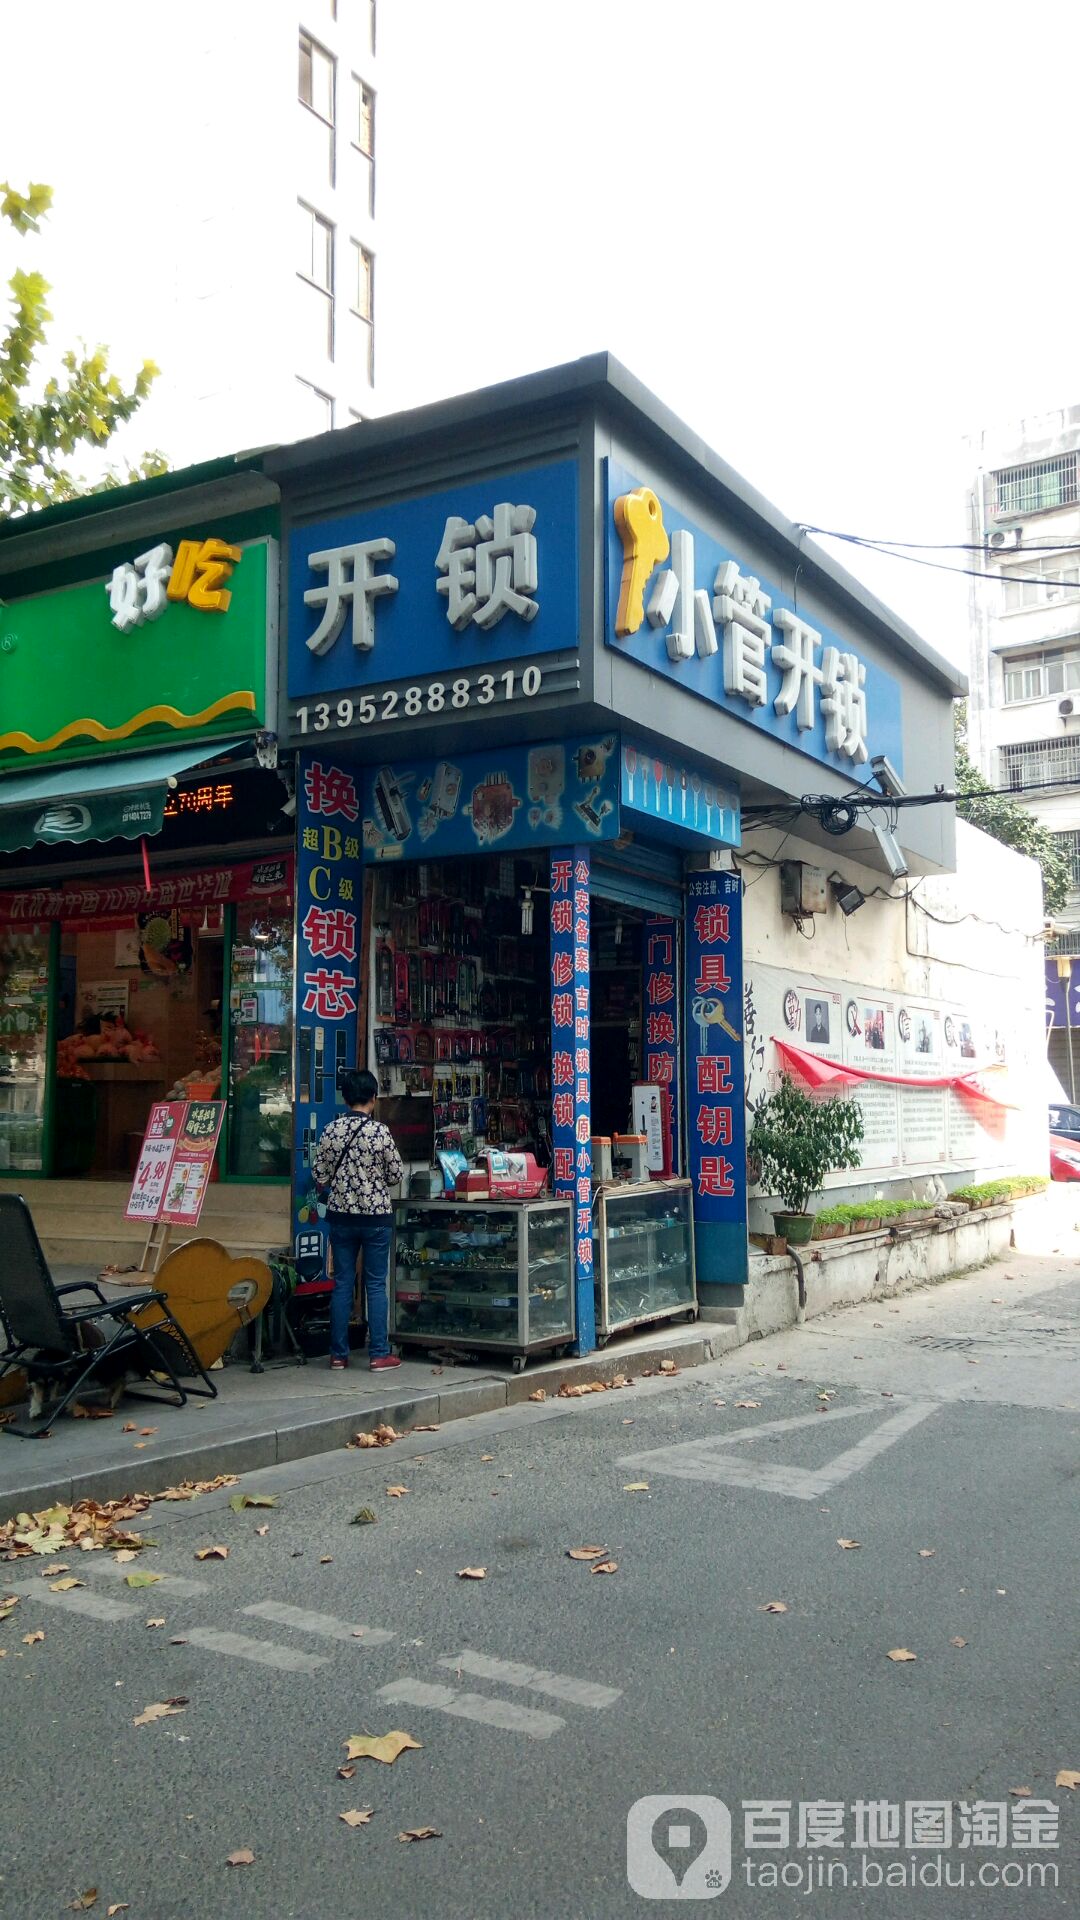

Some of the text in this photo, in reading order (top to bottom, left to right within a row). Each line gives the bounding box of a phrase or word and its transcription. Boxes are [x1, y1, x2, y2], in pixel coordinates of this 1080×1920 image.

[105, 538, 243, 634] 好吃
[304, 502, 540, 656] 开锁
[647, 530, 868, 765] 小管开锁
[296, 664, 543, 734] 13952888310
[304, 761, 359, 822] 换
[303, 825, 359, 862] 超B级
[308, 866, 355, 901] C级
[551, 860, 573, 934] 开锁
[302, 904, 358, 1021] 锁芯
[551, 952, 573, 1028] 修锁
[575, 860, 593, 1265] 公安备案 吉时锁具 原小管开锁
[693, 903, 735, 1197] 锁具 配钥匙
[552, 1051, 575, 1128] 换锁
